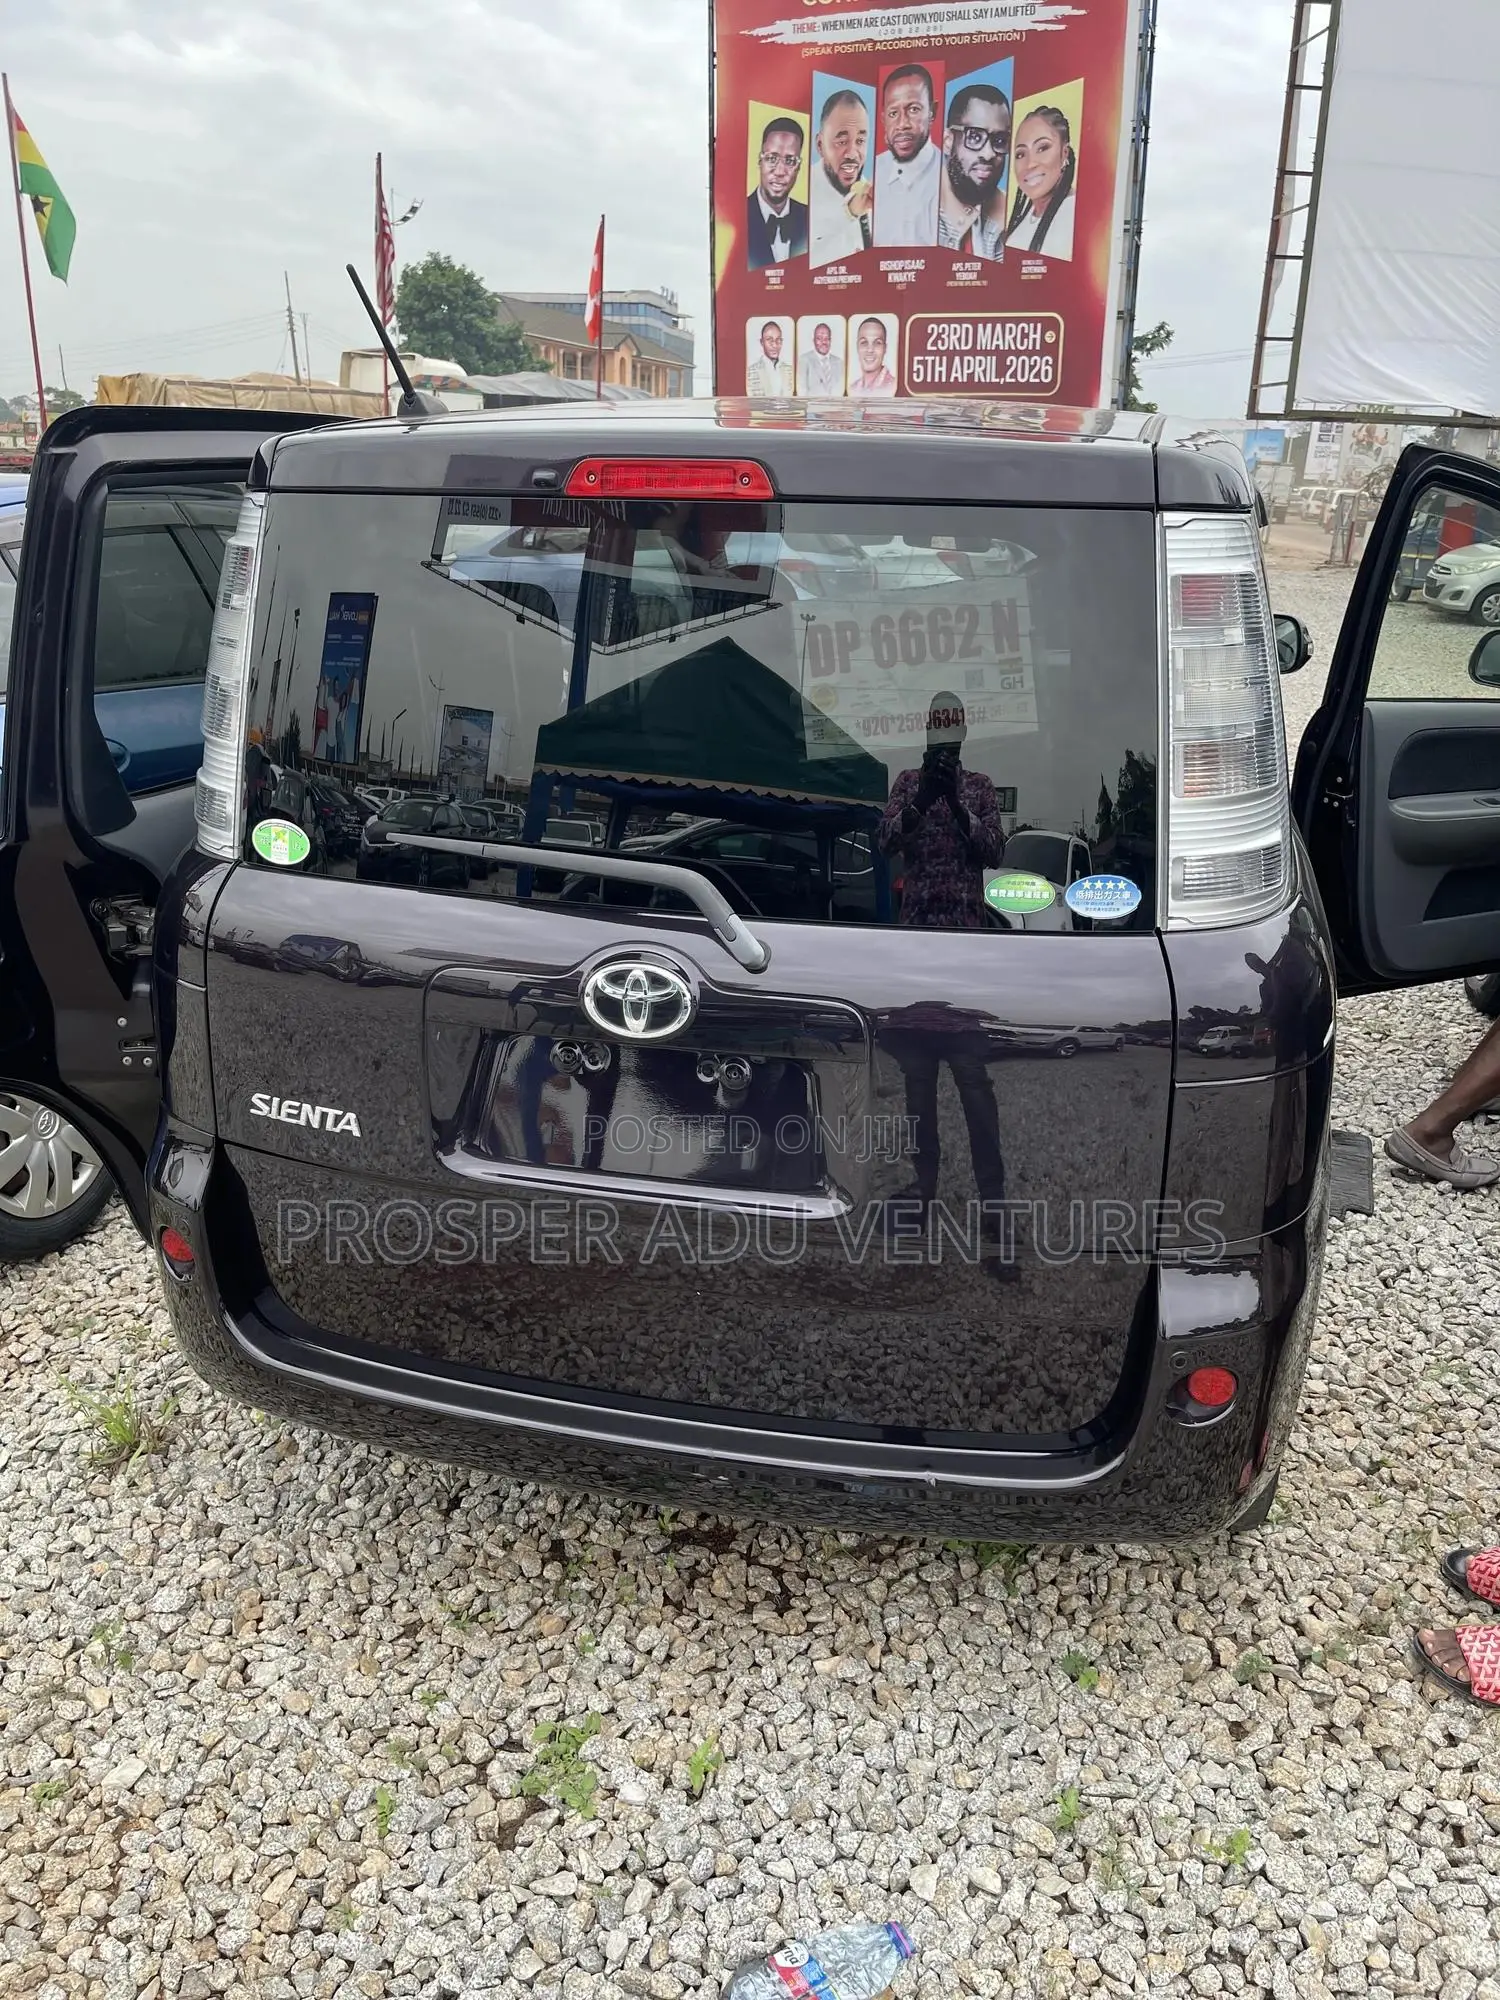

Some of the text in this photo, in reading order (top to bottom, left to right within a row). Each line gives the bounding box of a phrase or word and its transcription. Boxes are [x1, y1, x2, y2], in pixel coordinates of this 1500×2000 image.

[792, 22, 820, 34] THEME:
[821, 20, 844, 32] WHEN
[845, 18, 862, 30] MEN
[863, 16, 879, 28] ARE
[880, 15, 901, 26] CAST
[946, 9, 971, 21] SHALL
[973, 7, 990, 20] SAY
[994, 6, 1007, 18] AM
[1008, 5, 1036, 17] LIFTED
[802, 46, 832, 58] (SPEAK
[834, 43, 873, 54] POSITIVE
[875, 38, 928, 50] ACCORDING
[930, 38, 943, 47] TO
[944, 35, 970, 46] YOUR
[972, 32, 1020, 44] SITUATION
[926, 323, 1041, 351] 23RD MARCH
[912, 356, 947, 383] 5TH
[807, 597, 1020, 678] DP 6662 N
[1000, 673, 1024, 690] GH
[1075, 890, 1131, 901] 低排出ガス車
[250, 1092, 361, 1137] SIENTA
